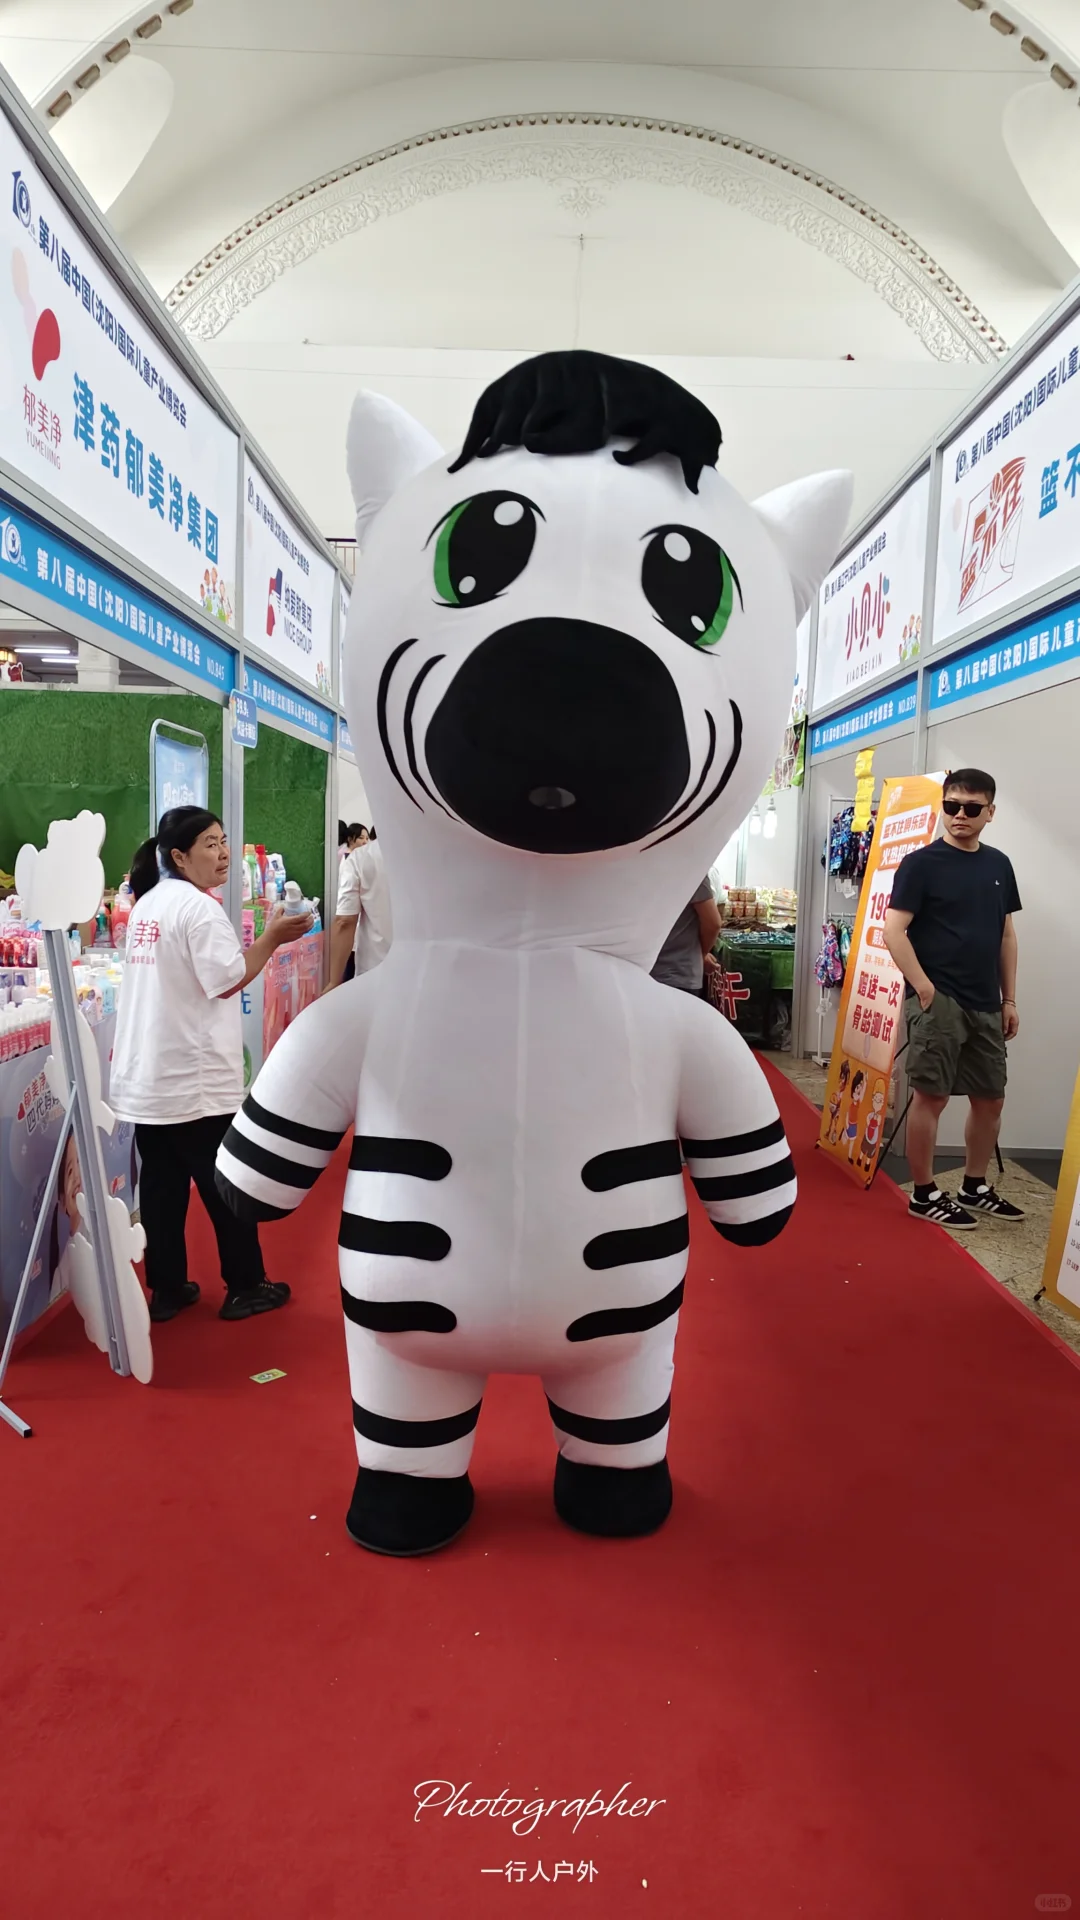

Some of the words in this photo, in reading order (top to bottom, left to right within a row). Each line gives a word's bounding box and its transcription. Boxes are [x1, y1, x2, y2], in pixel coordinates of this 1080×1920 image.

[39, 216, 187, 428] 第八届中国(沈阳)国际儿童产业博览会
[23, 383, 62, 449] 郁美净
[970, 346, 1080, 468] 第八届中国(沈阳)国际儿童
[73, 371, 218, 565] 津药郁美净集团
[37, 547, 201, 666] 第八届中国(沈阳)国际儿童产业博览会
[845, 572, 890, 661] 小贝心
[846, 651, 883, 685] XIAOBEIXIN
[955, 618, 1080, 690] 第八届中国(沈阳)国际儿童
[882, 812, 928, 840] 篮不住俱乐部
[852, 1004, 894, 1044] 骨龄测试
[857, 970, 901, 1009] 赠送一次
